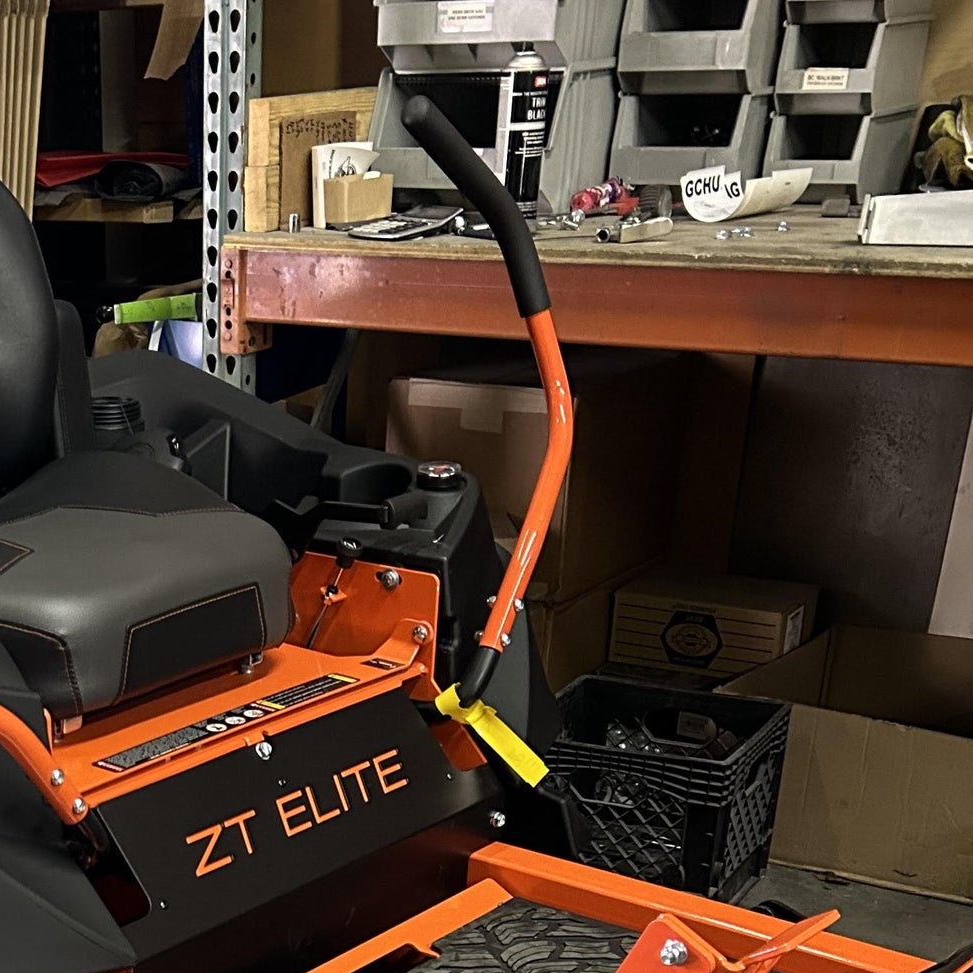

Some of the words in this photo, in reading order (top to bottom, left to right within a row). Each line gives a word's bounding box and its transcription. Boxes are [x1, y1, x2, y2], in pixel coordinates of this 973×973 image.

[685, 174, 721, 198] GCHU
[185, 809, 257, 878] ZT
[275, 748, 410, 838] ELITE
